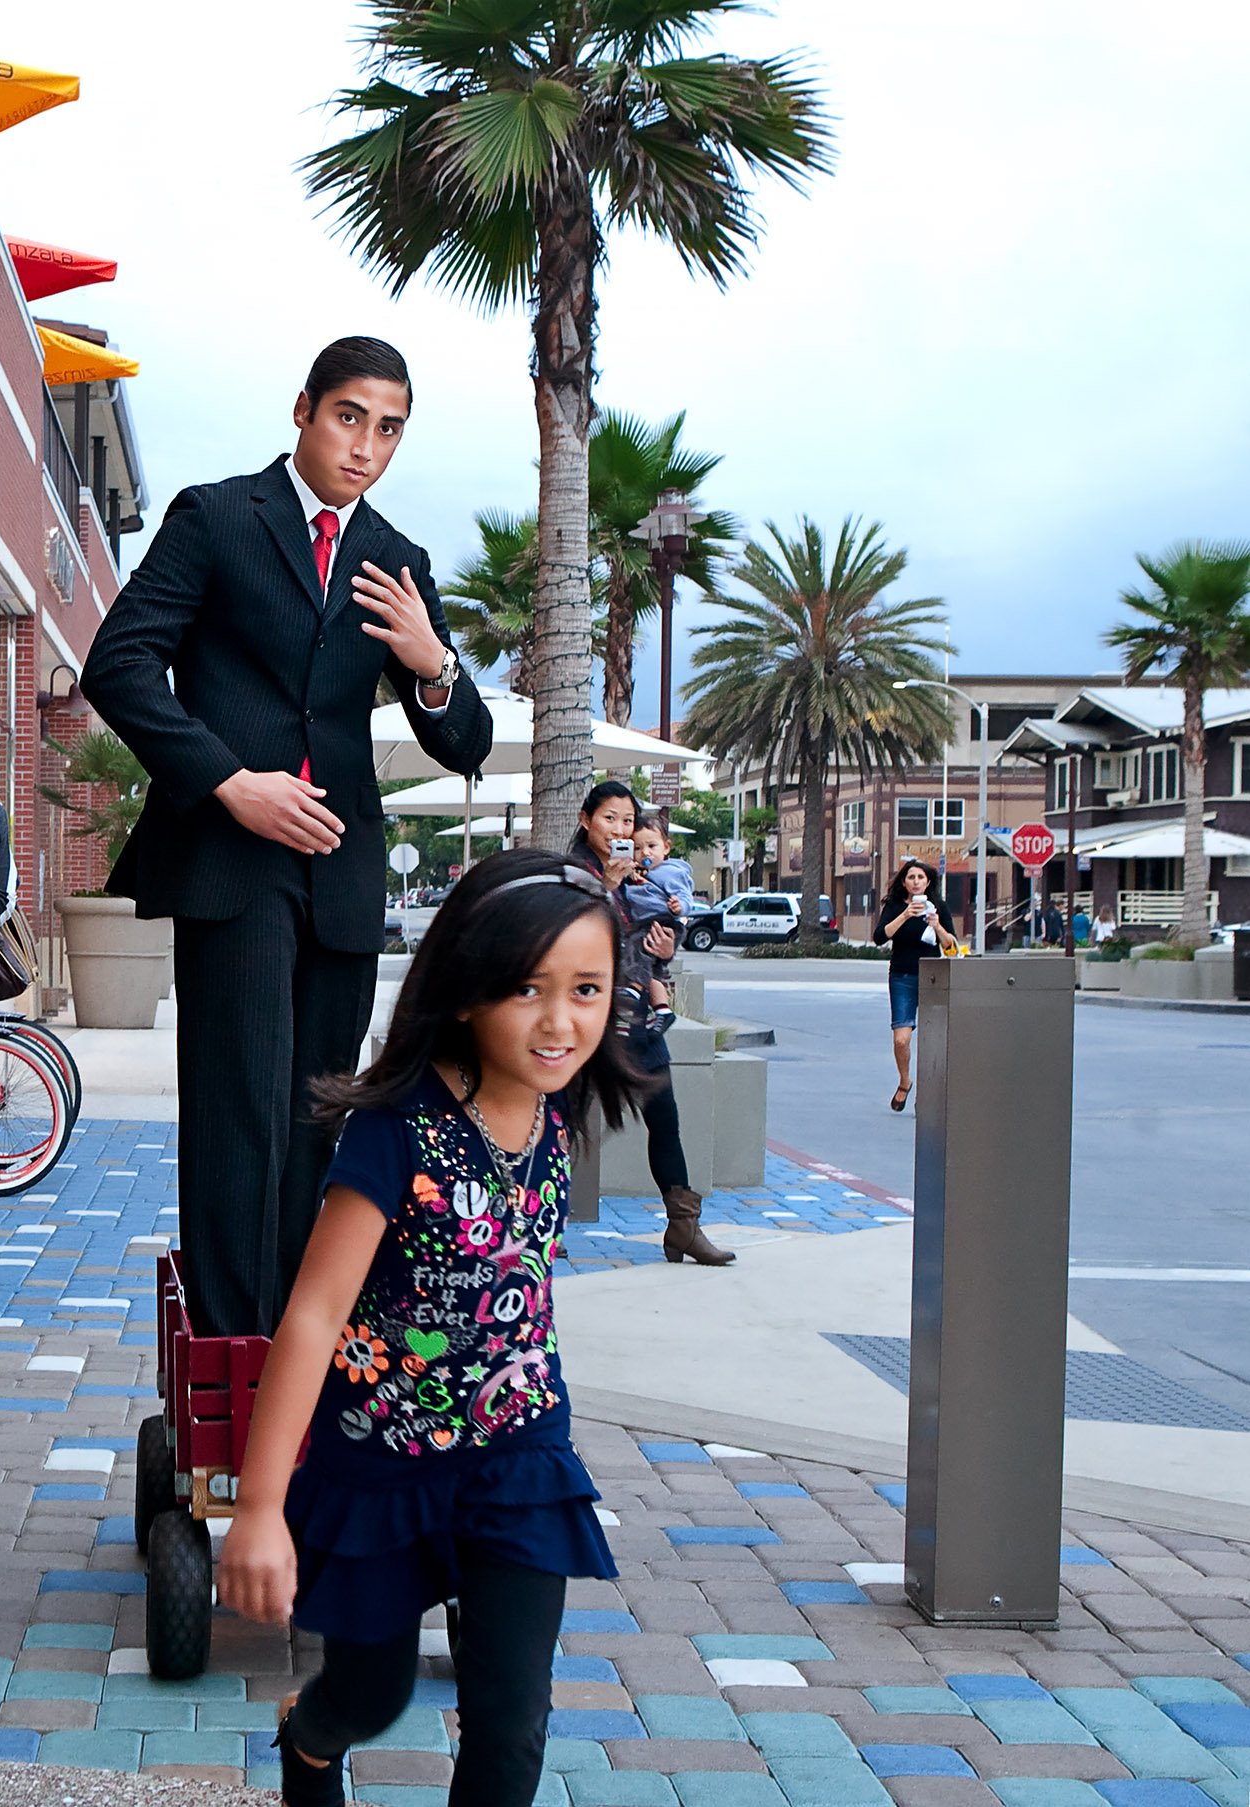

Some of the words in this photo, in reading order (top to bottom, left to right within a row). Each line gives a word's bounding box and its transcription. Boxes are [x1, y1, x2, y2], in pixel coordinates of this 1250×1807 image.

[1014, 835, 1052, 854] STOP
[412, 1262, 494, 1289] Friends
[412, 1303, 470, 1330] Ever
